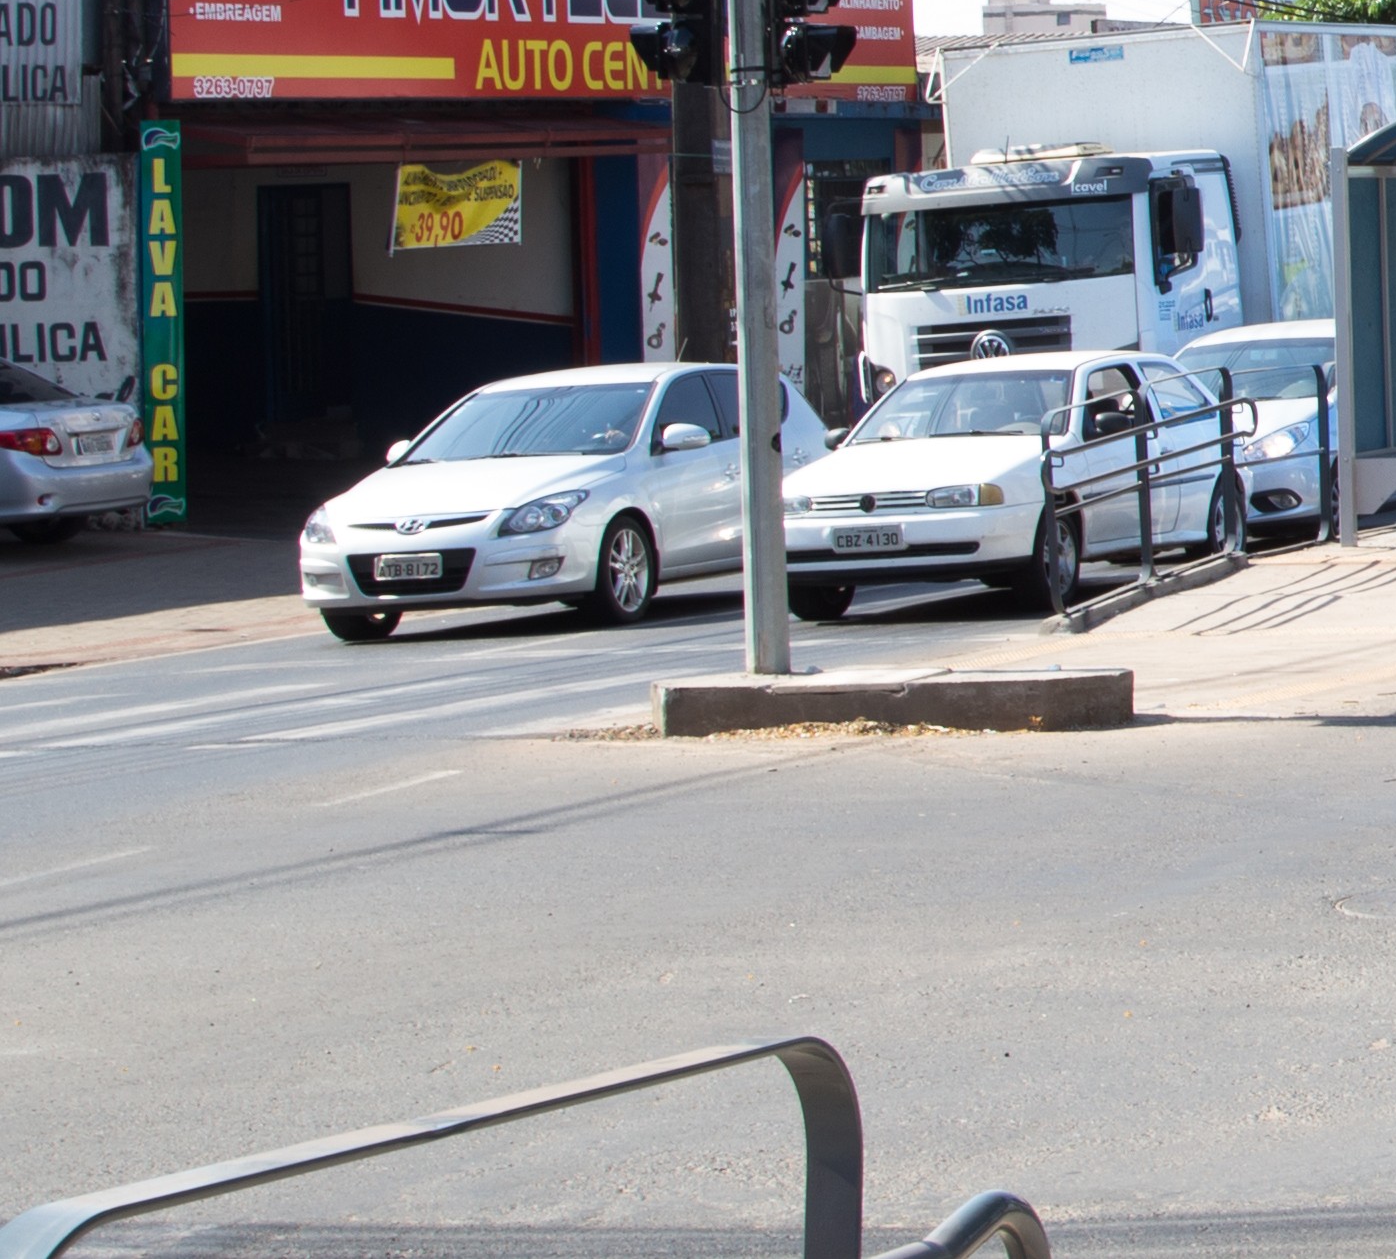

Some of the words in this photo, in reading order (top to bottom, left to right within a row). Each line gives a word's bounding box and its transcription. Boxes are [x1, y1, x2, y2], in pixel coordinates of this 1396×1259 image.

[195, 2, 281, 22] EMBREAGEM
[475, 39, 573, 91] AUTO
[193, 77, 274, 98] 3263-0797
[148, 158, 177, 317] LAVA
[966, 294, 1028, 315] Infasa
[150, 363, 178, 483] CAR
